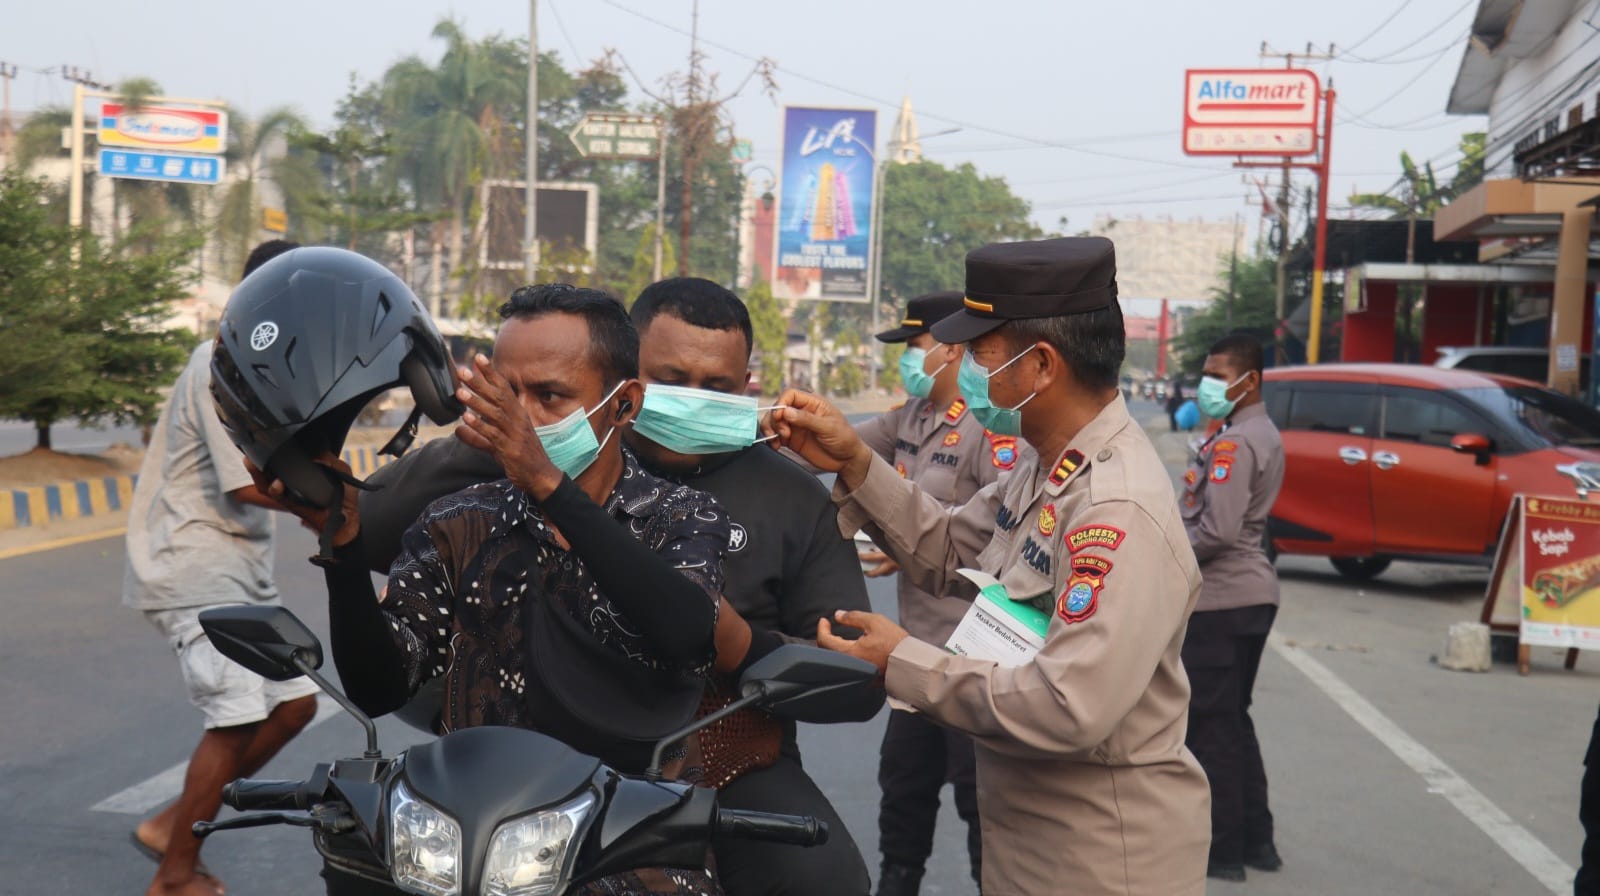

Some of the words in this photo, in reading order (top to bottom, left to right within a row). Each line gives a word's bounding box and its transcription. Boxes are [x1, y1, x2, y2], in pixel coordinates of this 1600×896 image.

[1197, 80, 1306, 100] Alfamart
[931, 452, 959, 467] POLRI
[1070, 528, 1118, 546] POLRESTA
[1531, 528, 1576, 545] Kebab
[1539, 541, 1569, 558] Sapi
[976, 612, 996, 629] Masker
[995, 626, 1012, 642] Bedah
